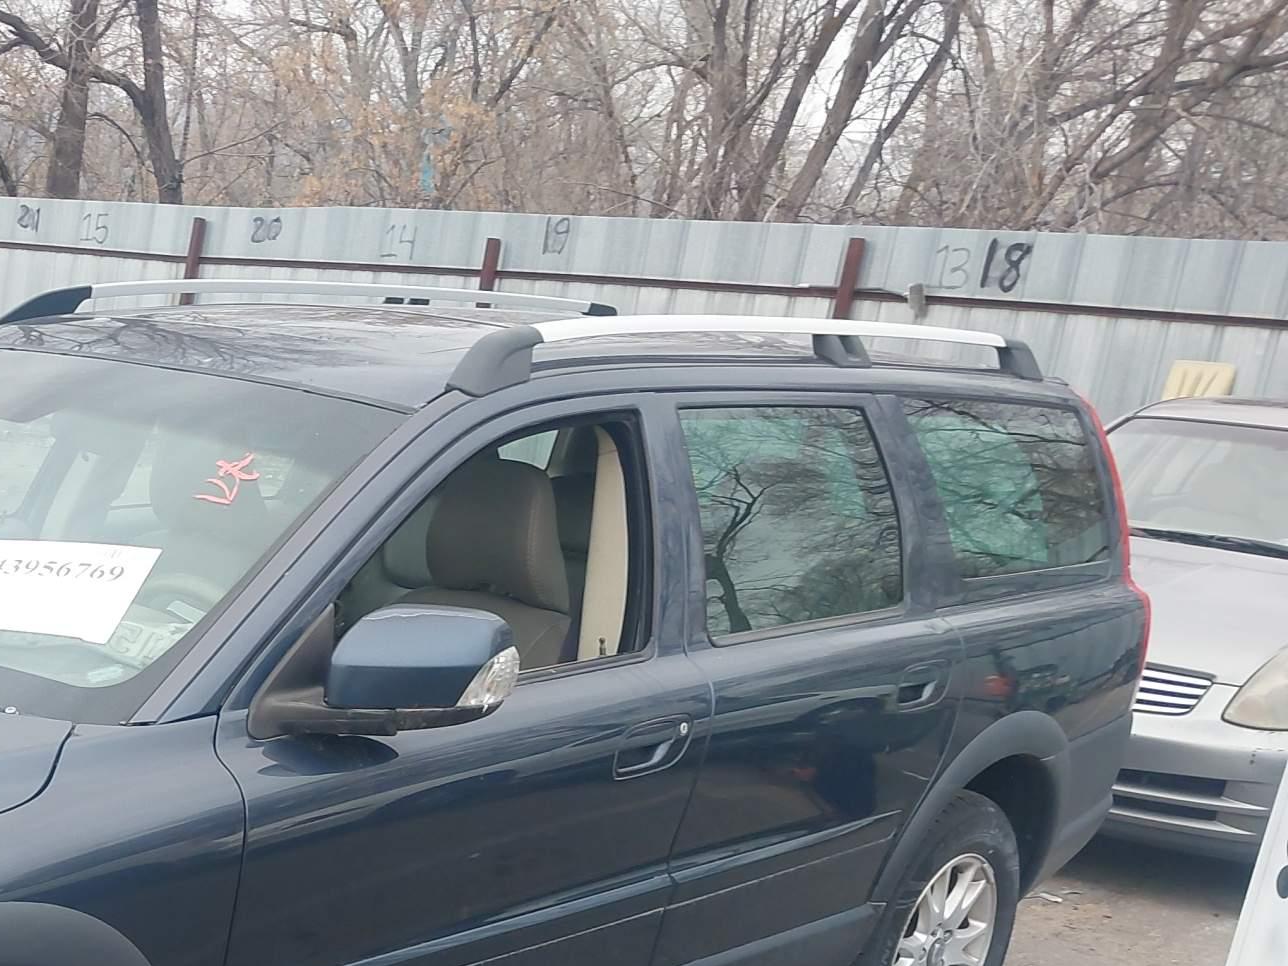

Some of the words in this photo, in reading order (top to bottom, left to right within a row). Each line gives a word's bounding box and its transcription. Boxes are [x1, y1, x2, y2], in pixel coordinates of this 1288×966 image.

[79, 213, 110, 245] 15
[250, 216, 283, 244] 20
[379, 223, 418, 261] 14
[542, 216, 571, 256] 19
[924, 244, 972, 290] 13
[979, 237, 1034, 294] 18
